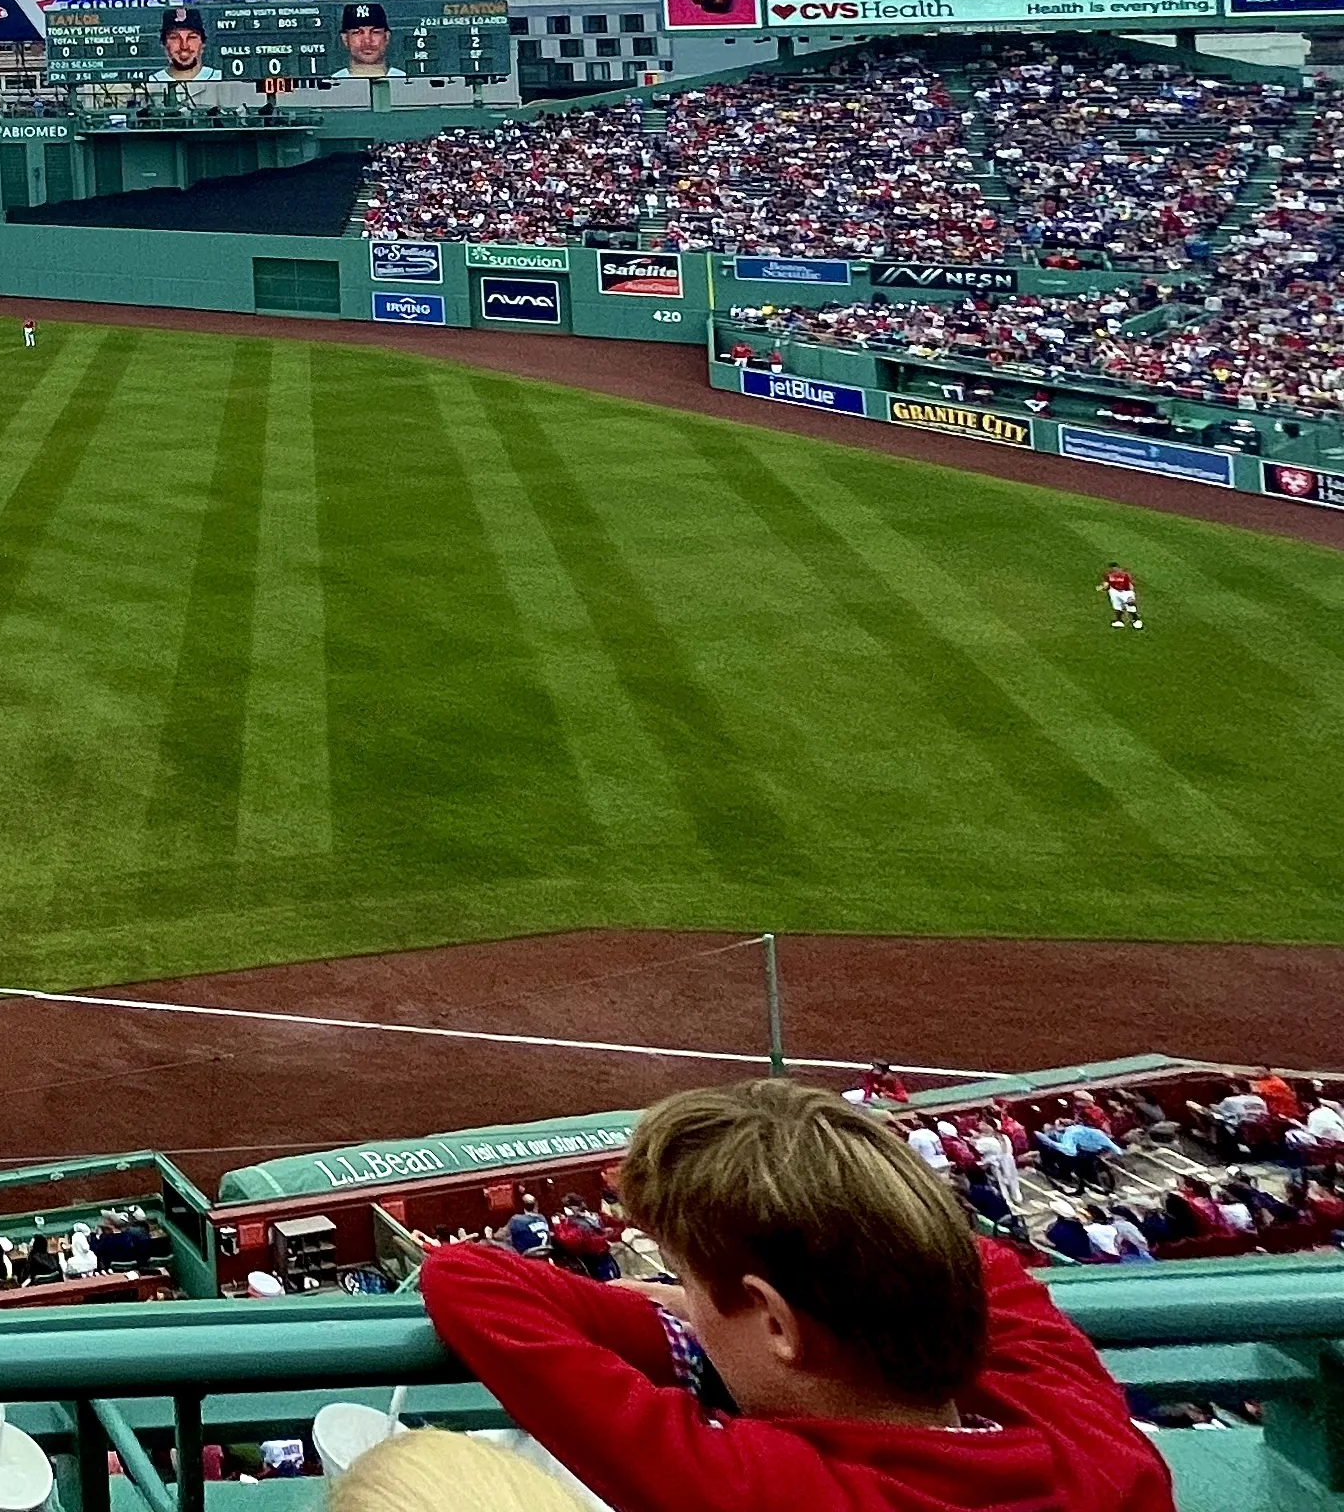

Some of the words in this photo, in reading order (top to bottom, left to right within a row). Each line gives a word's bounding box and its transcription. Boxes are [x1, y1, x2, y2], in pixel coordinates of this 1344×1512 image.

[1027, 1, 1084, 15] Health
[231, 58, 245, 76] 0
[268, 57, 282, 75] 0
[2, 125, 68, 138] ABIOMED
[488, 250, 563, 268] sunovion
[602, 262, 678, 278] Safelite
[945, 271, 1012, 287] NESN
[385, 302, 431, 316] IRVING
[652, 310, 682, 323] 420
[768, 375, 835, 405] jetBlue
[892, 401, 978, 429] GRANITE
[981, 412, 1030, 444] CITY
[314, 1145, 445, 1189] L.L.Bean
